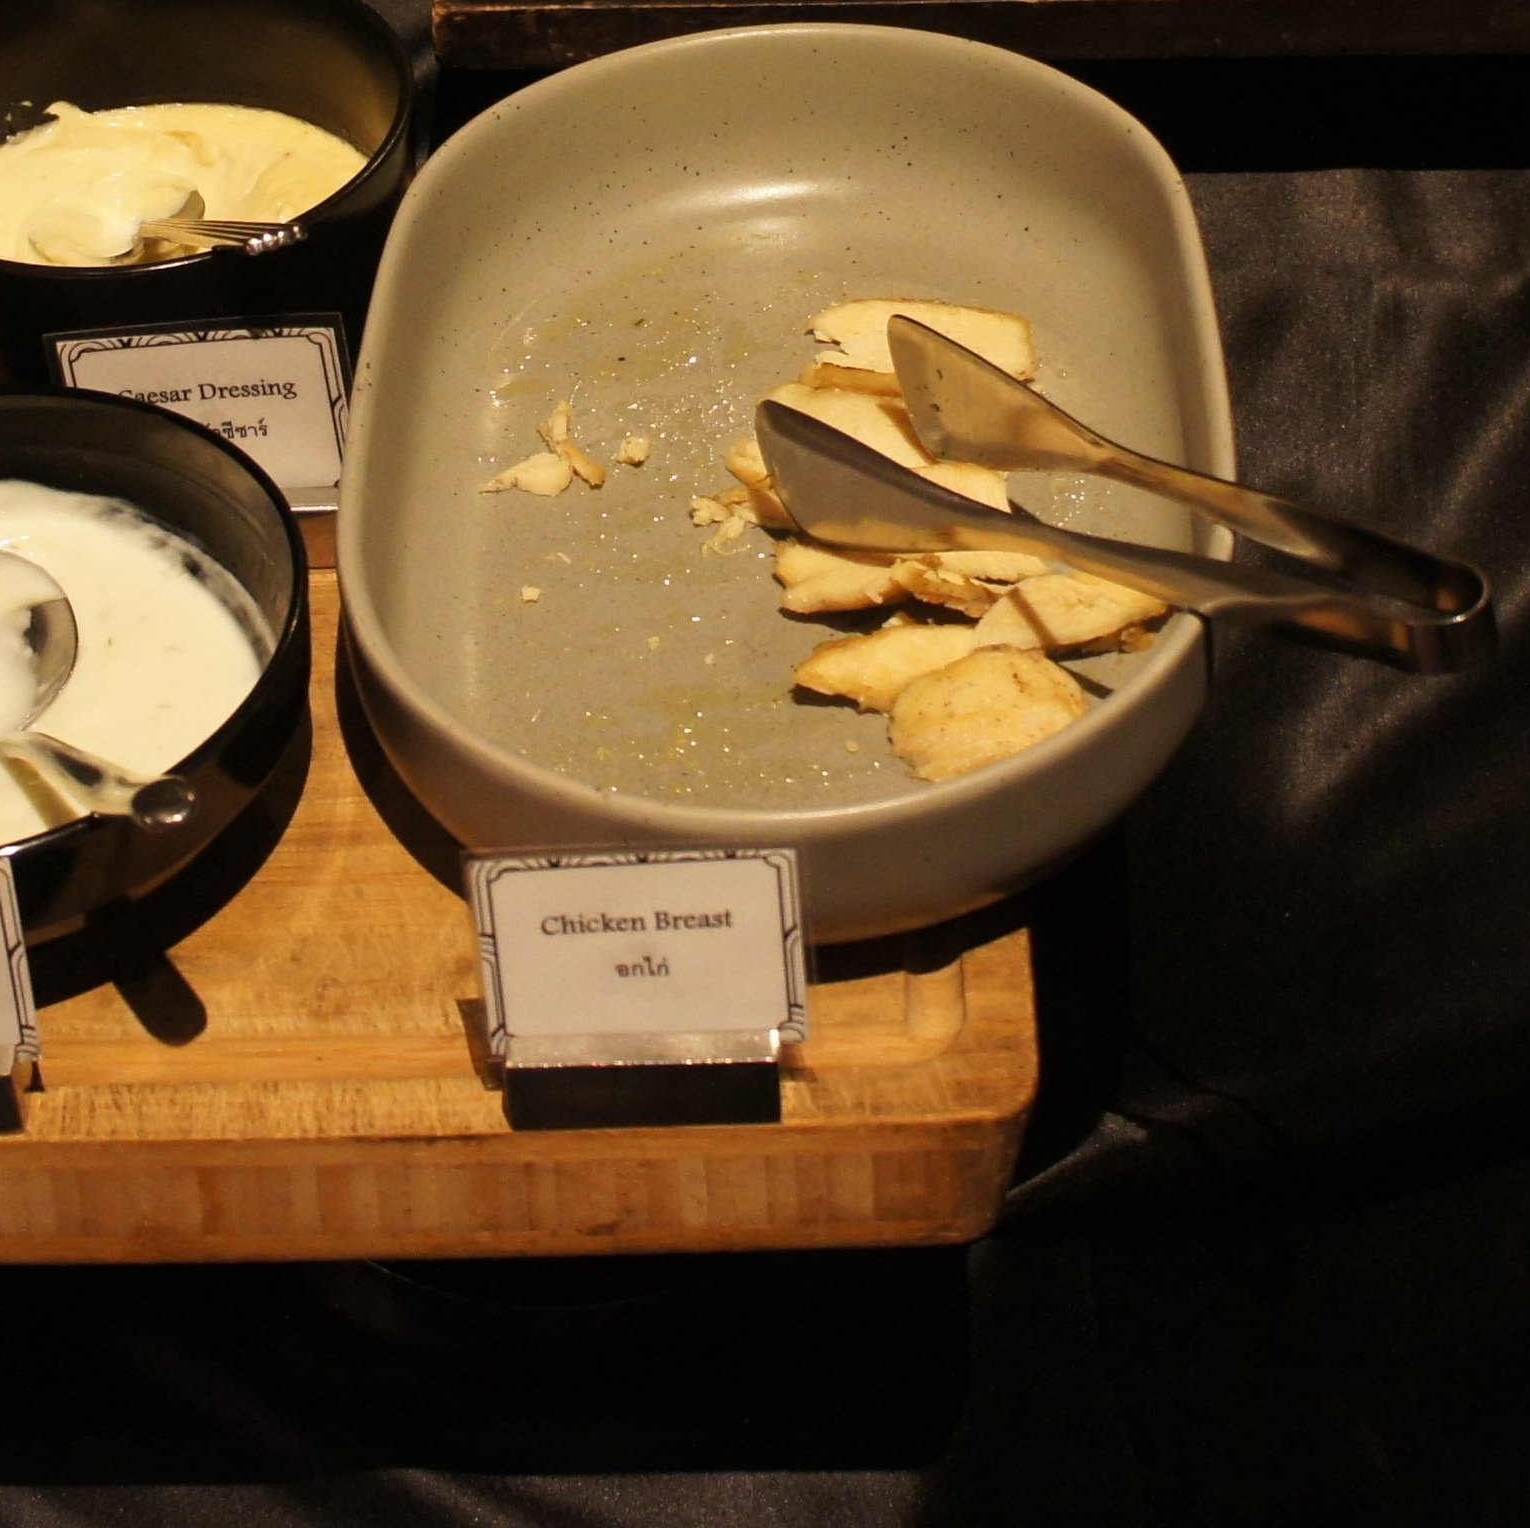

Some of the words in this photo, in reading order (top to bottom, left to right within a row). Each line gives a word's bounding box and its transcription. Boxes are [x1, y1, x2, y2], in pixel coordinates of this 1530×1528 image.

[199, 379, 297, 400] Dressing
[541, 914, 646, 936] Chicken
[655, 910, 733, 931] Breast
[615, 956, 670, 977] อกไก่
